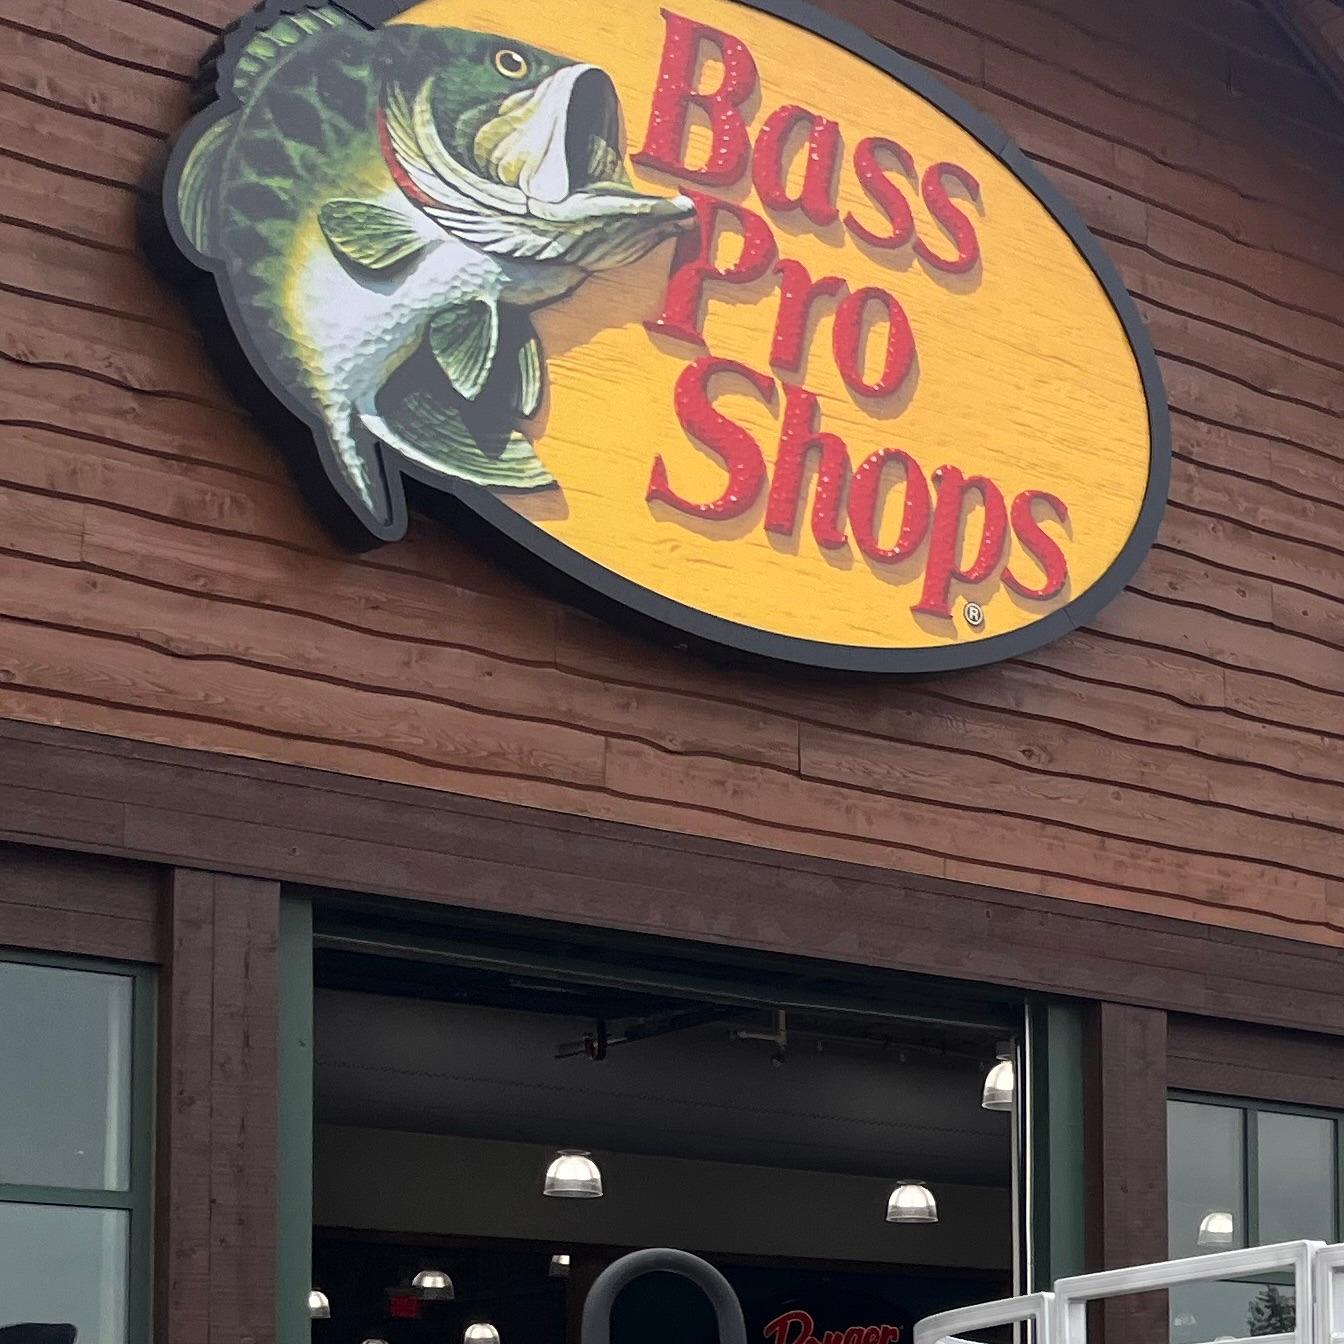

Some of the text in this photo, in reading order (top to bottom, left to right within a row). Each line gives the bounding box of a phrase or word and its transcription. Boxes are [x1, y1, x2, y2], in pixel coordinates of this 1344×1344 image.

[630, 6, 983, 276] Bass
[643, 186, 915, 401] Pro
[646, 357, 1069, 619] Shops
